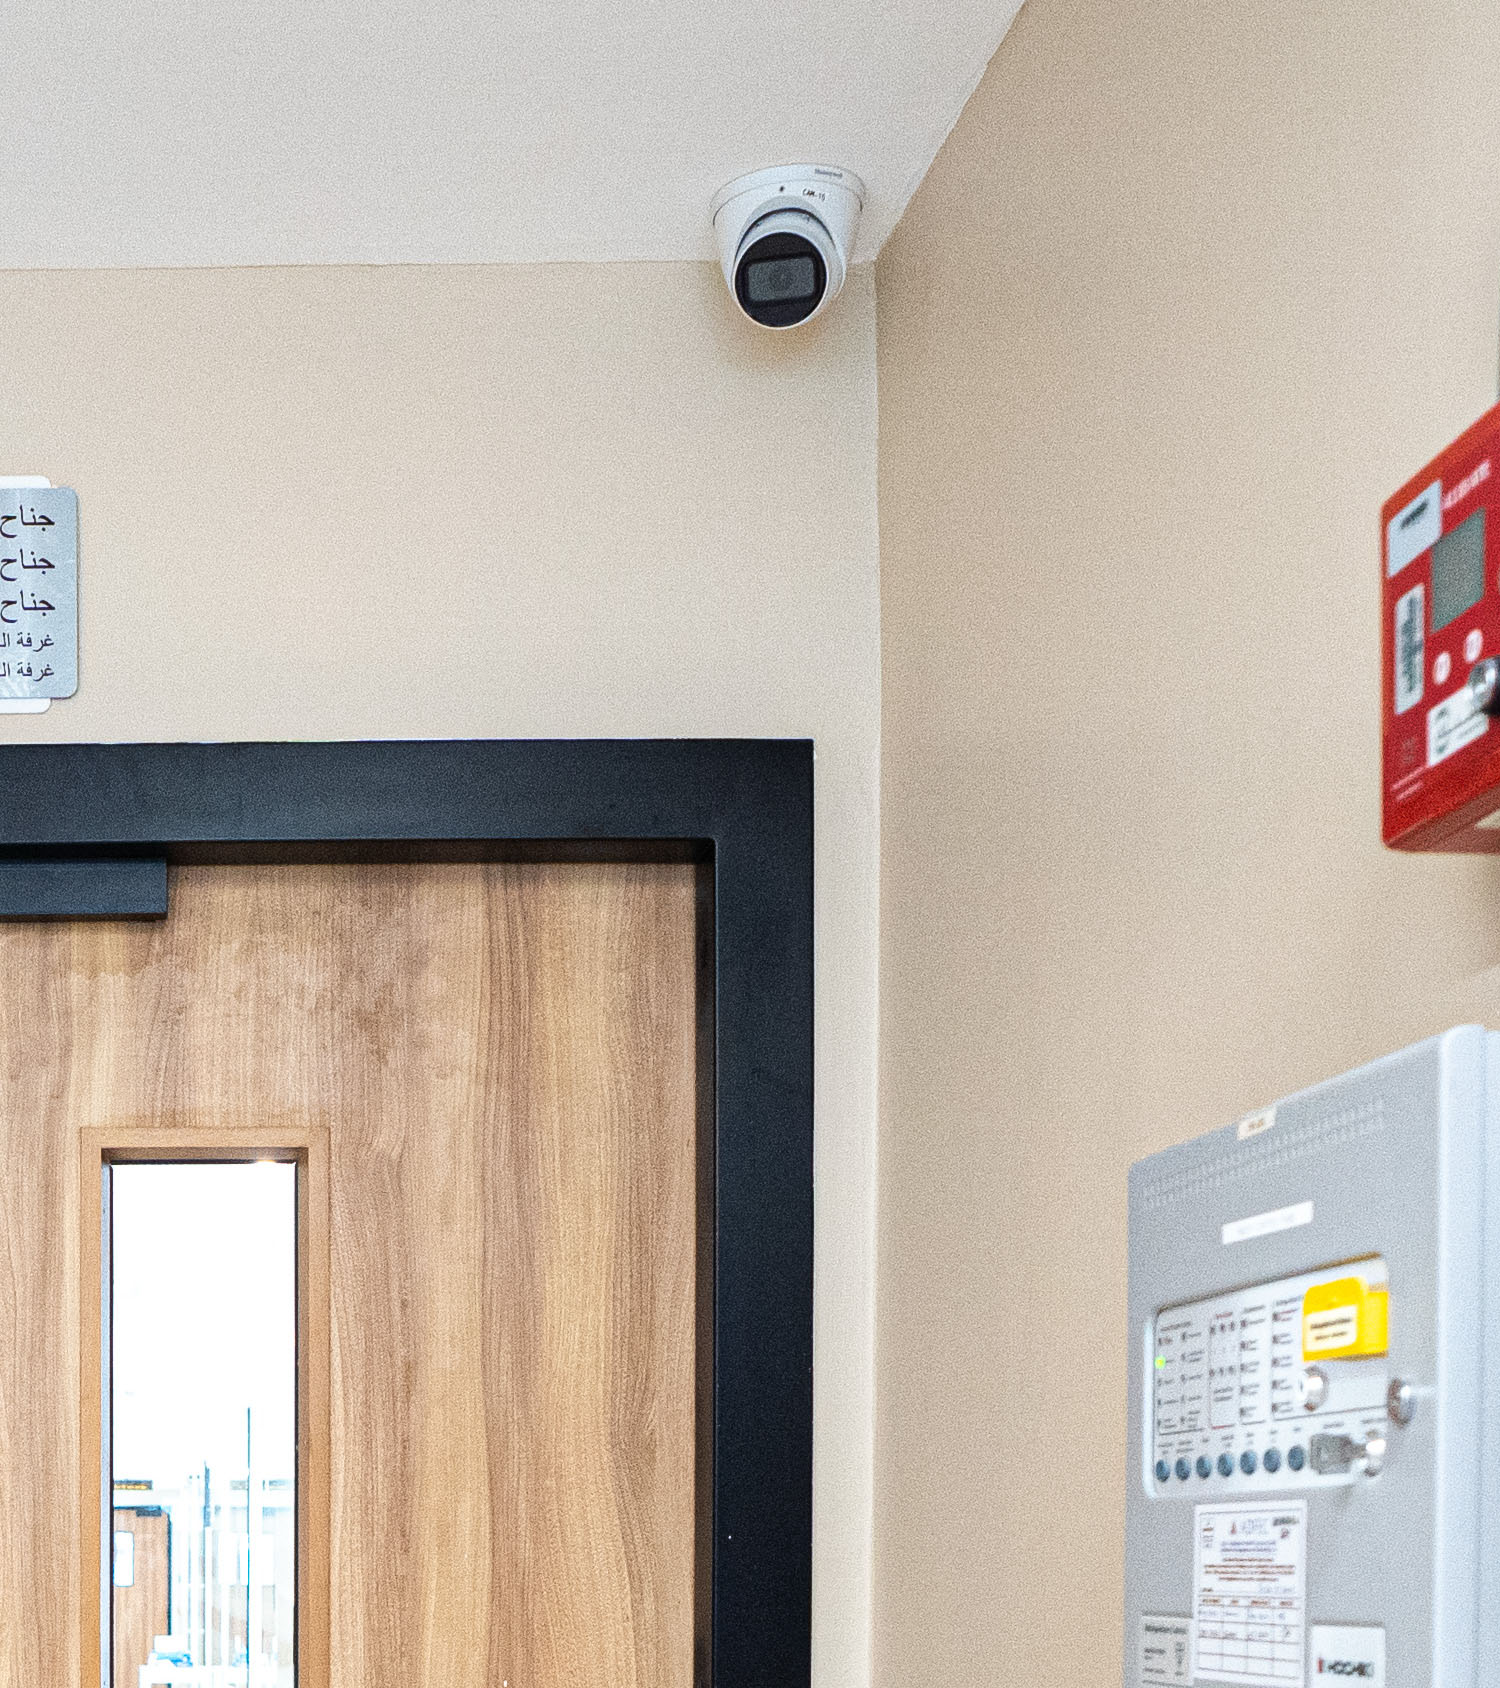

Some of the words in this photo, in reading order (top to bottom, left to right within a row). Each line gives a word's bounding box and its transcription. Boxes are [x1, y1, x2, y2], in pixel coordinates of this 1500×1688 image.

[0, 504, 56, 538] جناح
[0, 548, 56, 582] جناح
[0, 590, 56, 624] جناح
[16, 632, 55, 652] غرفة
[16, 662, 55, 682] غرفة
